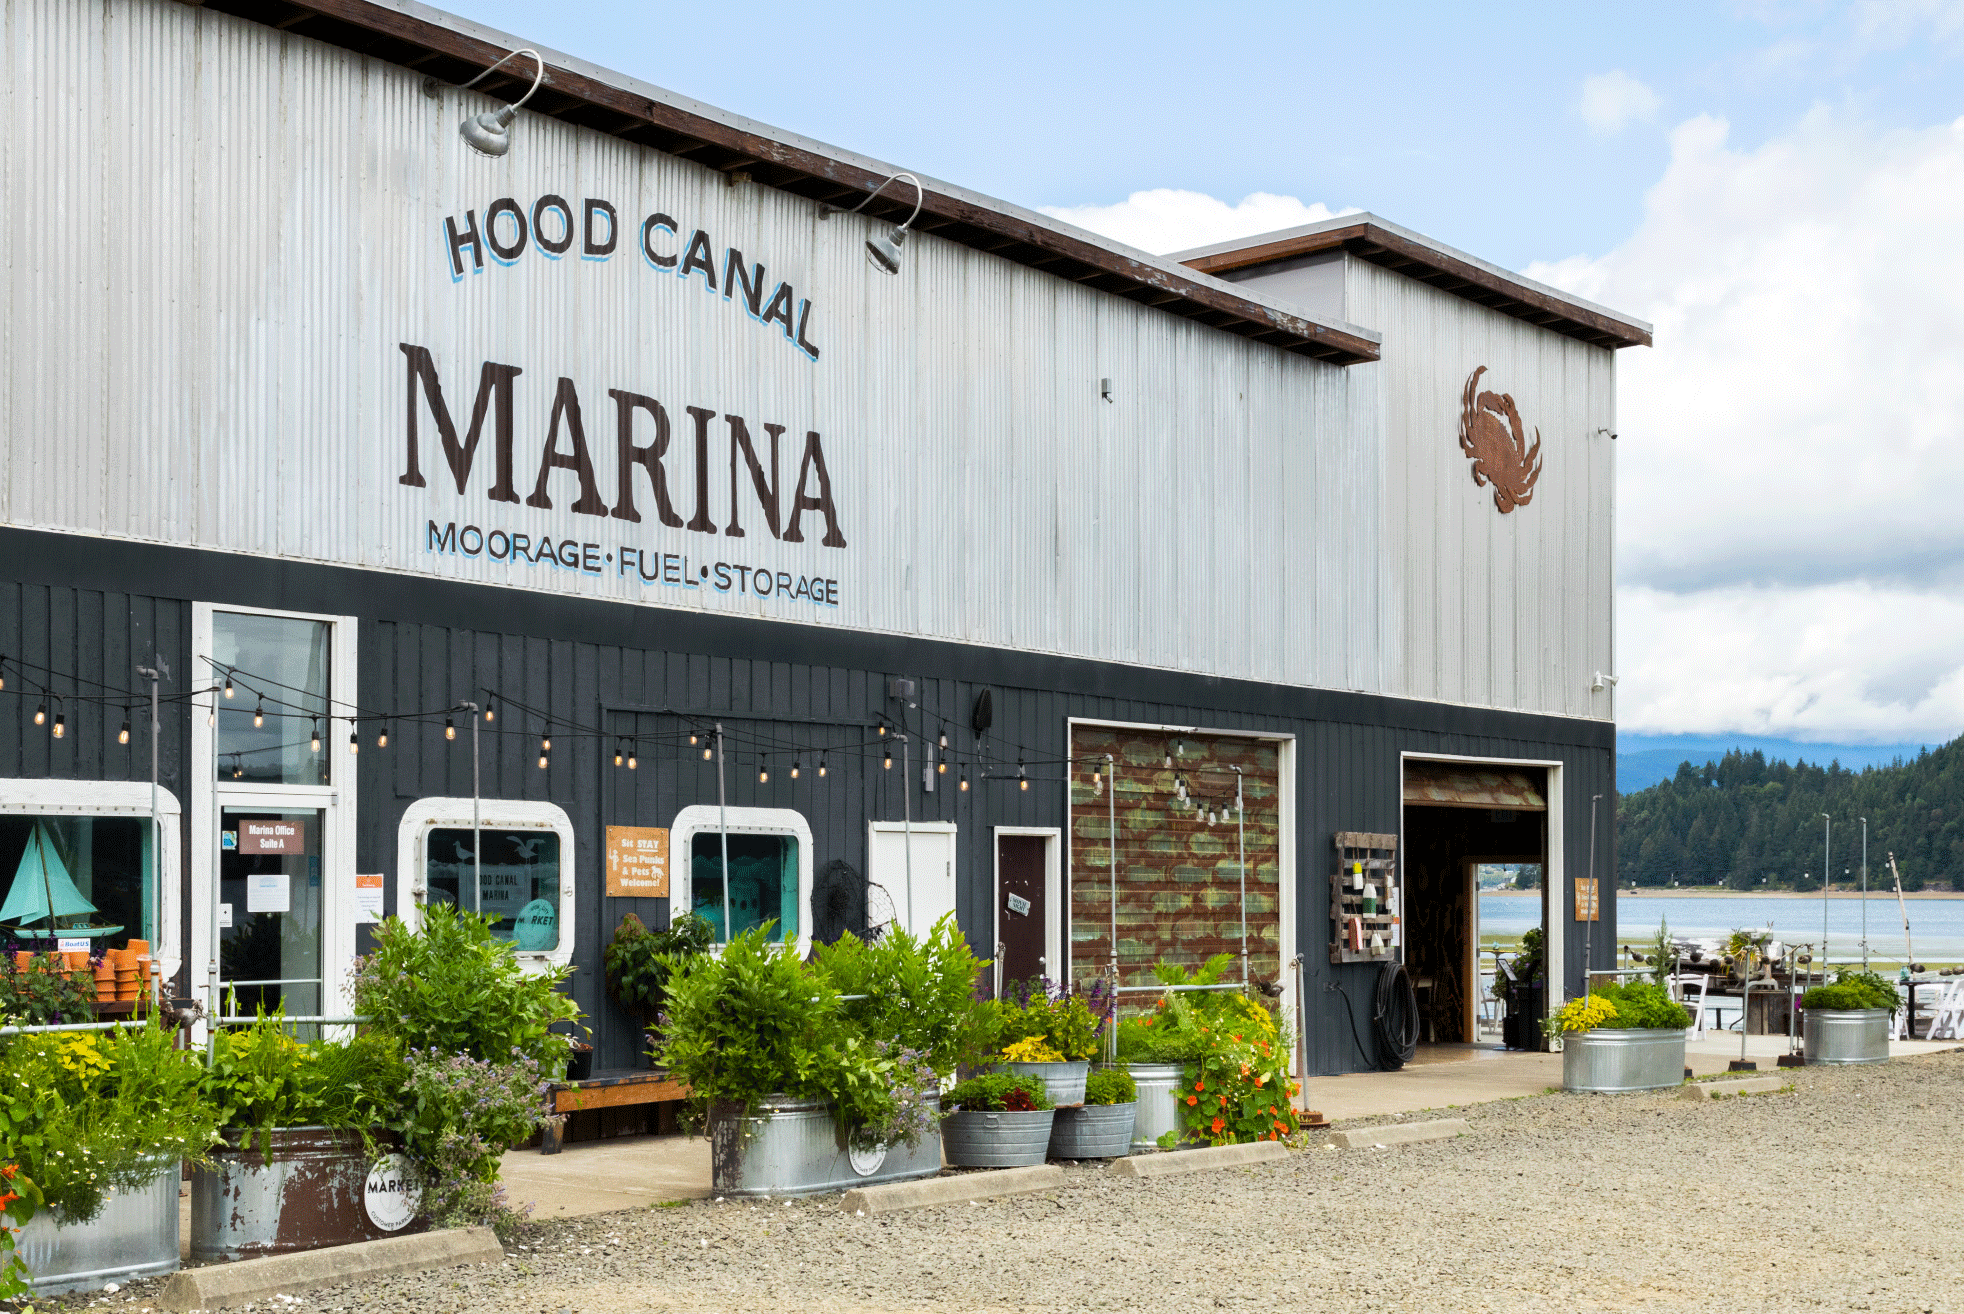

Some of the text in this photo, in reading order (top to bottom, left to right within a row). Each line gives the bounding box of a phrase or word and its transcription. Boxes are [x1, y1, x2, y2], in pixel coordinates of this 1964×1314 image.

[443, 194, 820, 362] HOOD CANAL
[399, 342, 847, 548] MARINA
[426, 520, 839, 606] MOORAGE FUEL STORAGE
[249, 825, 295, 835] Marina Office
[260, 838, 285, 849] Suite A
[621, 838, 660, 849] Sit STAY
[622, 854, 665, 865] Sea Punks
[622, 866, 650, 876] & Pets
[496, 874, 518, 886] CANAL
[620, 878, 660, 887] Welcome!
[482, 889, 509, 901] MARINA
[517, 915, 554, 926] MRKET
[371, 1210, 395, 1228] CUSTOMER
